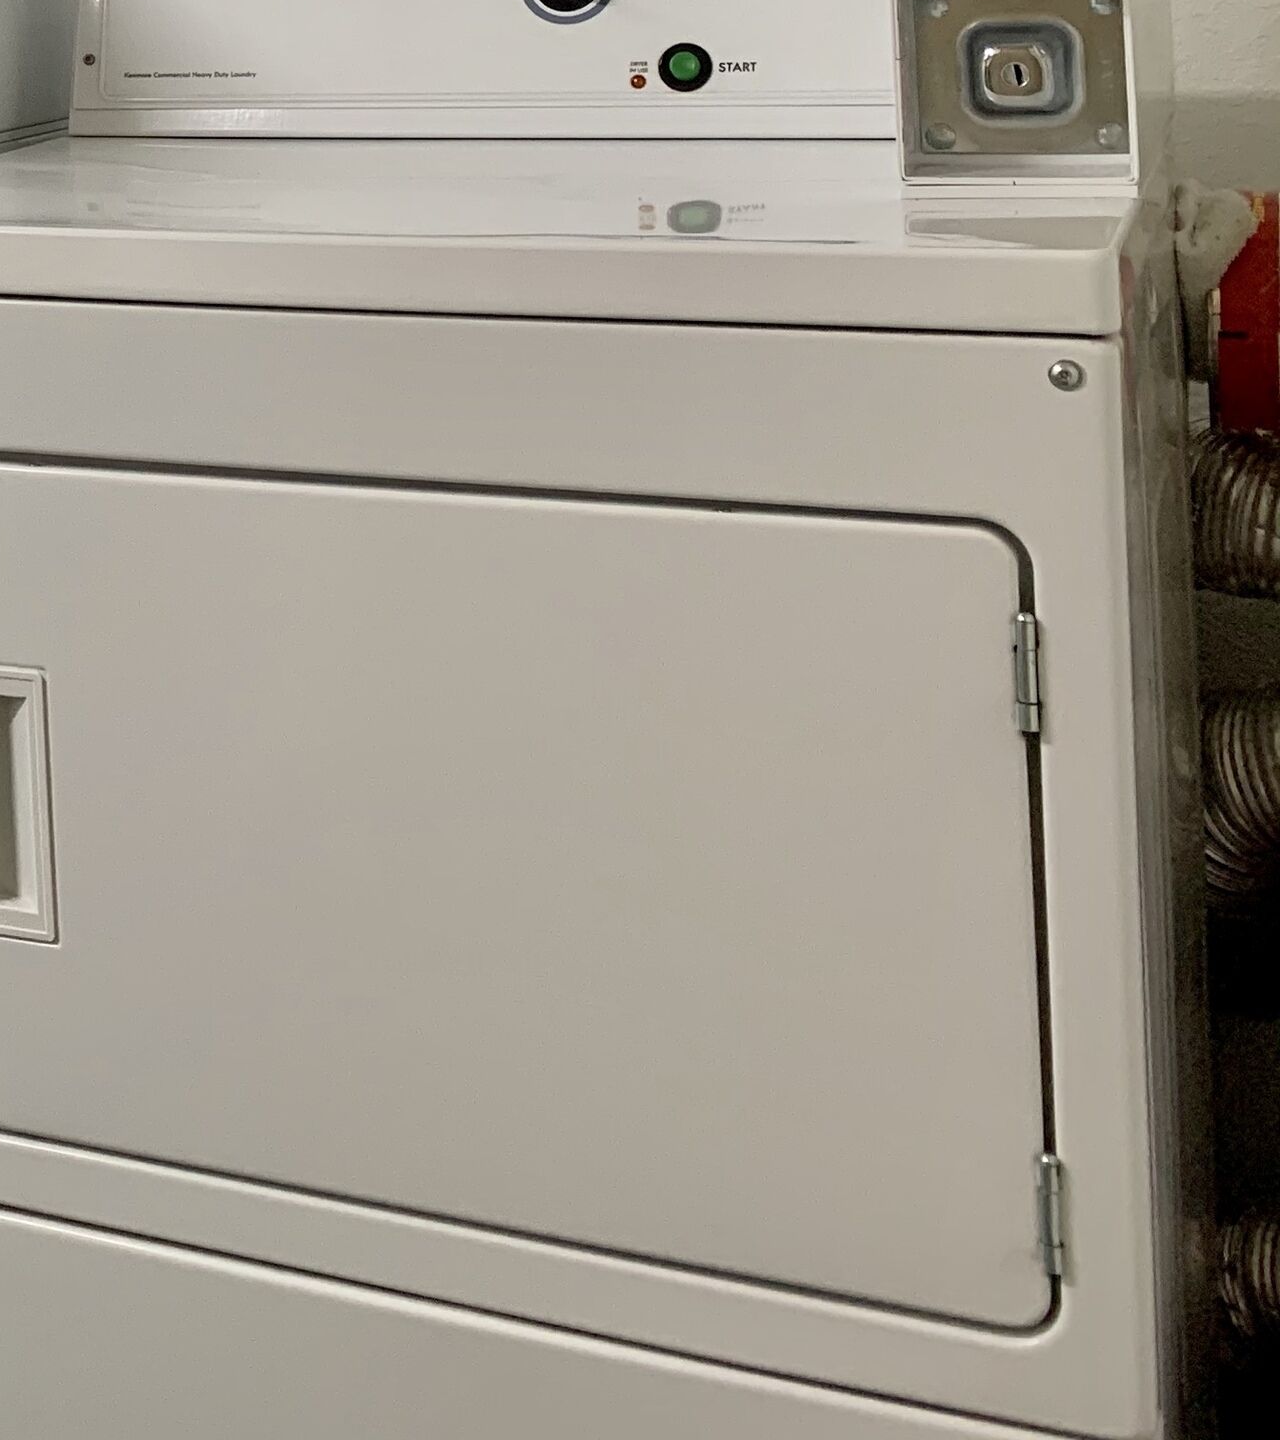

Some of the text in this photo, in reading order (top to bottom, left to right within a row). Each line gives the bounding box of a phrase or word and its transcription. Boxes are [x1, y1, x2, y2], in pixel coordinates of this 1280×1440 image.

[718, 62, 757, 73] START
[192, 71, 213, 79] Heavy
[230, 71, 257, 79] Laundry
